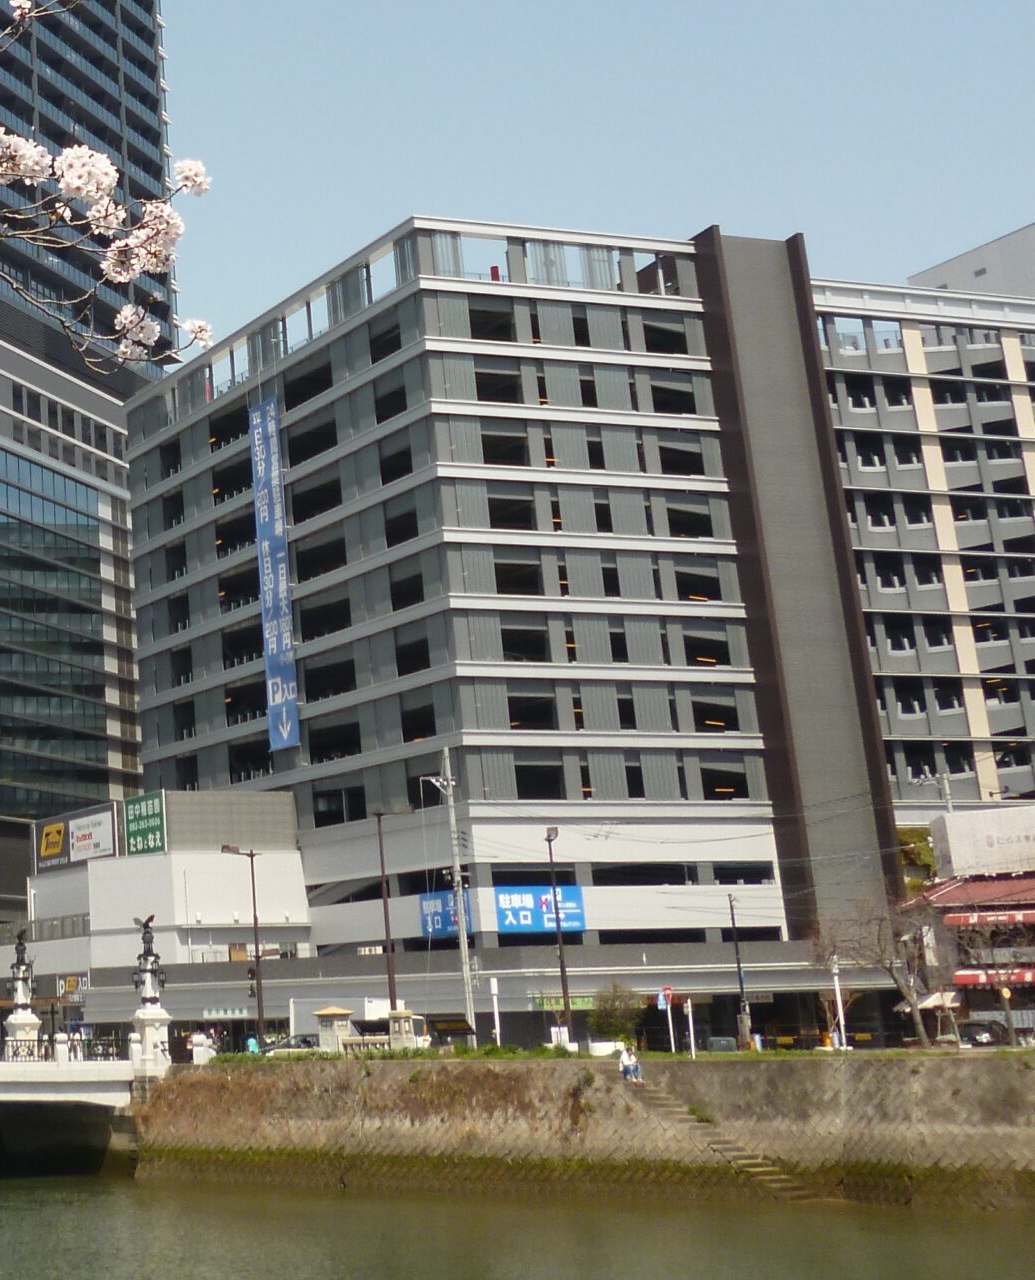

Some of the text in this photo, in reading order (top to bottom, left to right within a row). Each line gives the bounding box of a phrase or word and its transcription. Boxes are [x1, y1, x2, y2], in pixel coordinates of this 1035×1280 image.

[282, 682, 297, 702] 入口
[499, 893, 535, 909] 駐車場
[505, 911, 532, 925] 入口
